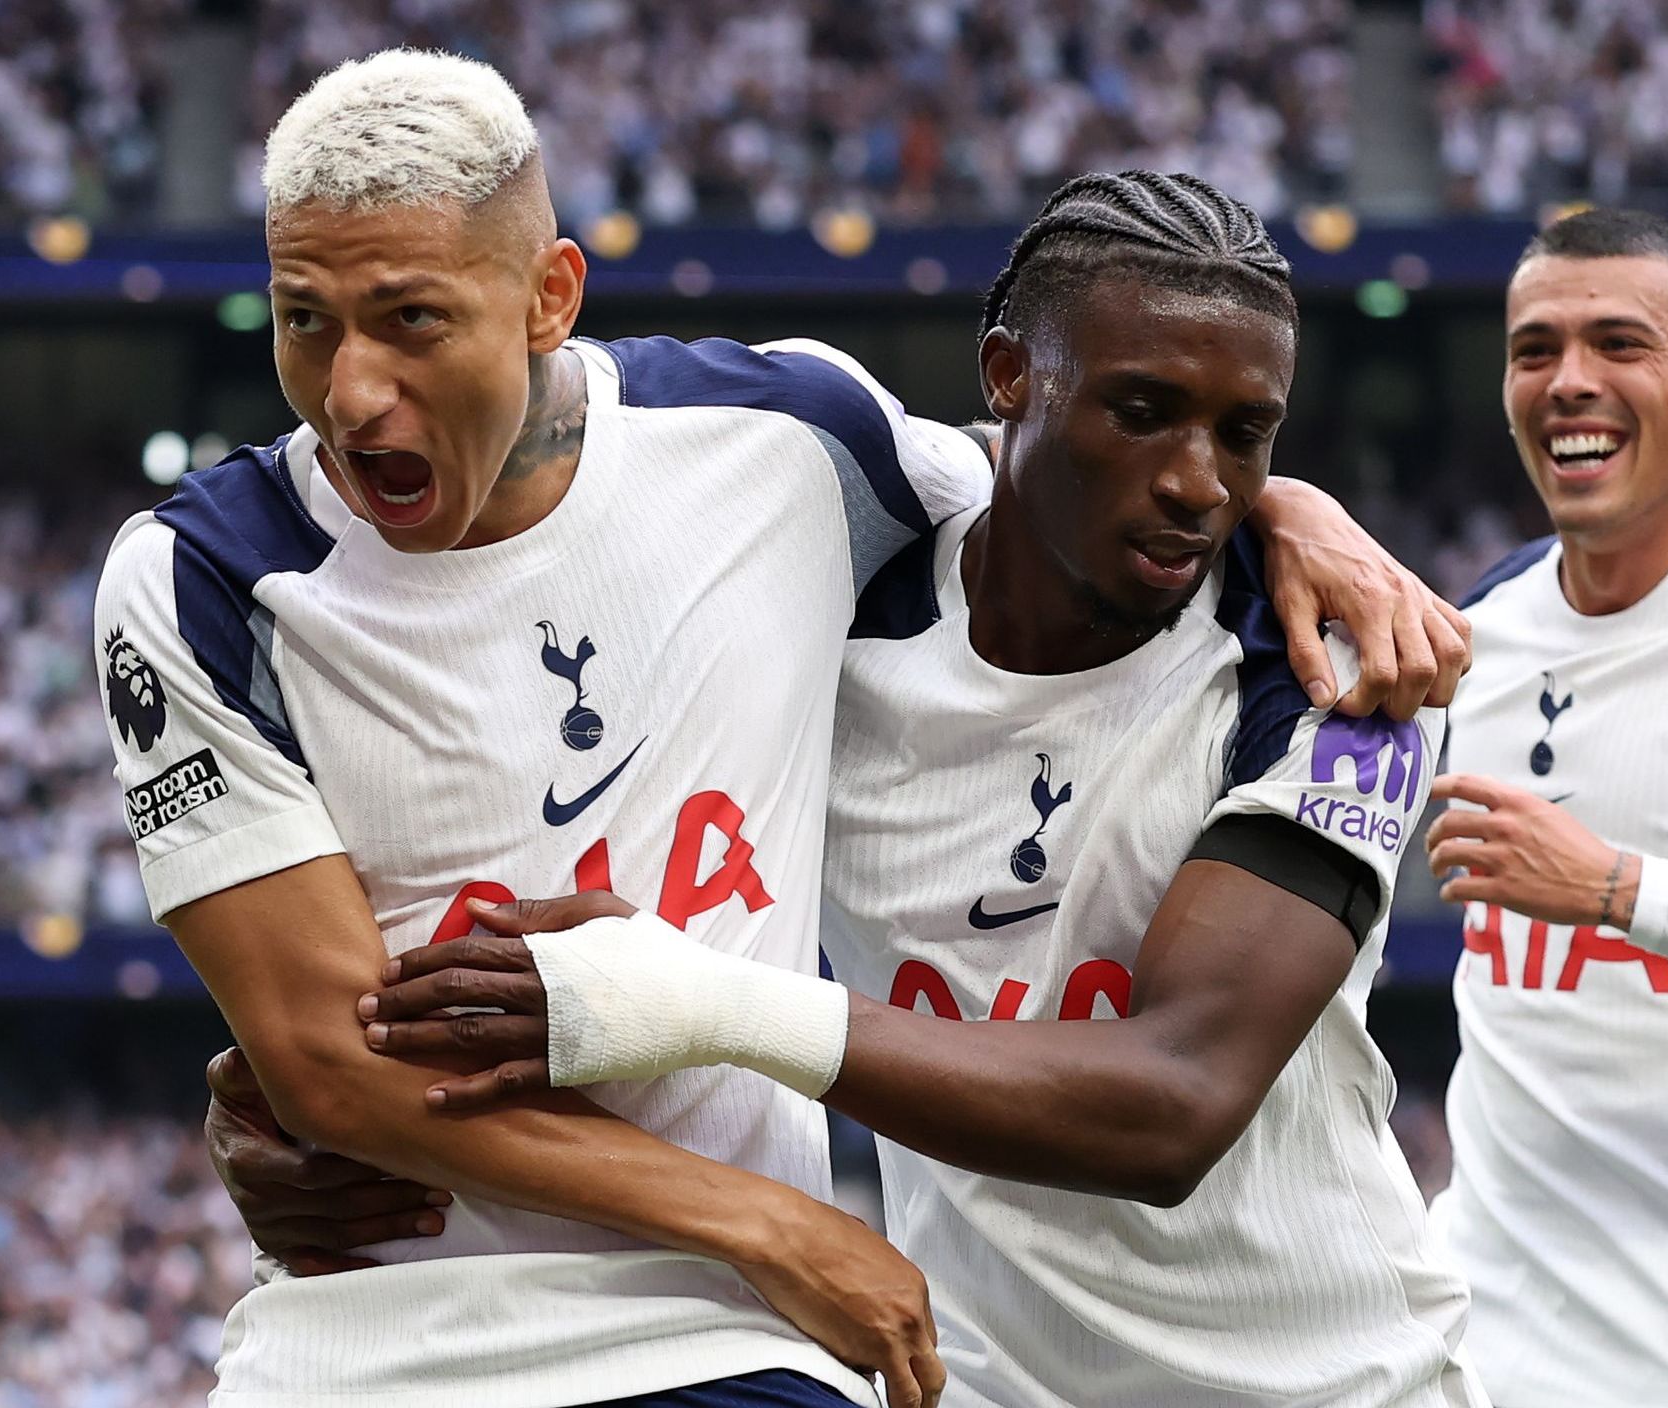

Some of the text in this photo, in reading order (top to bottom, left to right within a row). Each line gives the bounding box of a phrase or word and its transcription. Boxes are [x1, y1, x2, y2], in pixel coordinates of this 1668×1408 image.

[126, 761, 208, 818] No room
[132, 776, 228, 840] for racism
[1295, 792, 1406, 856] krake
